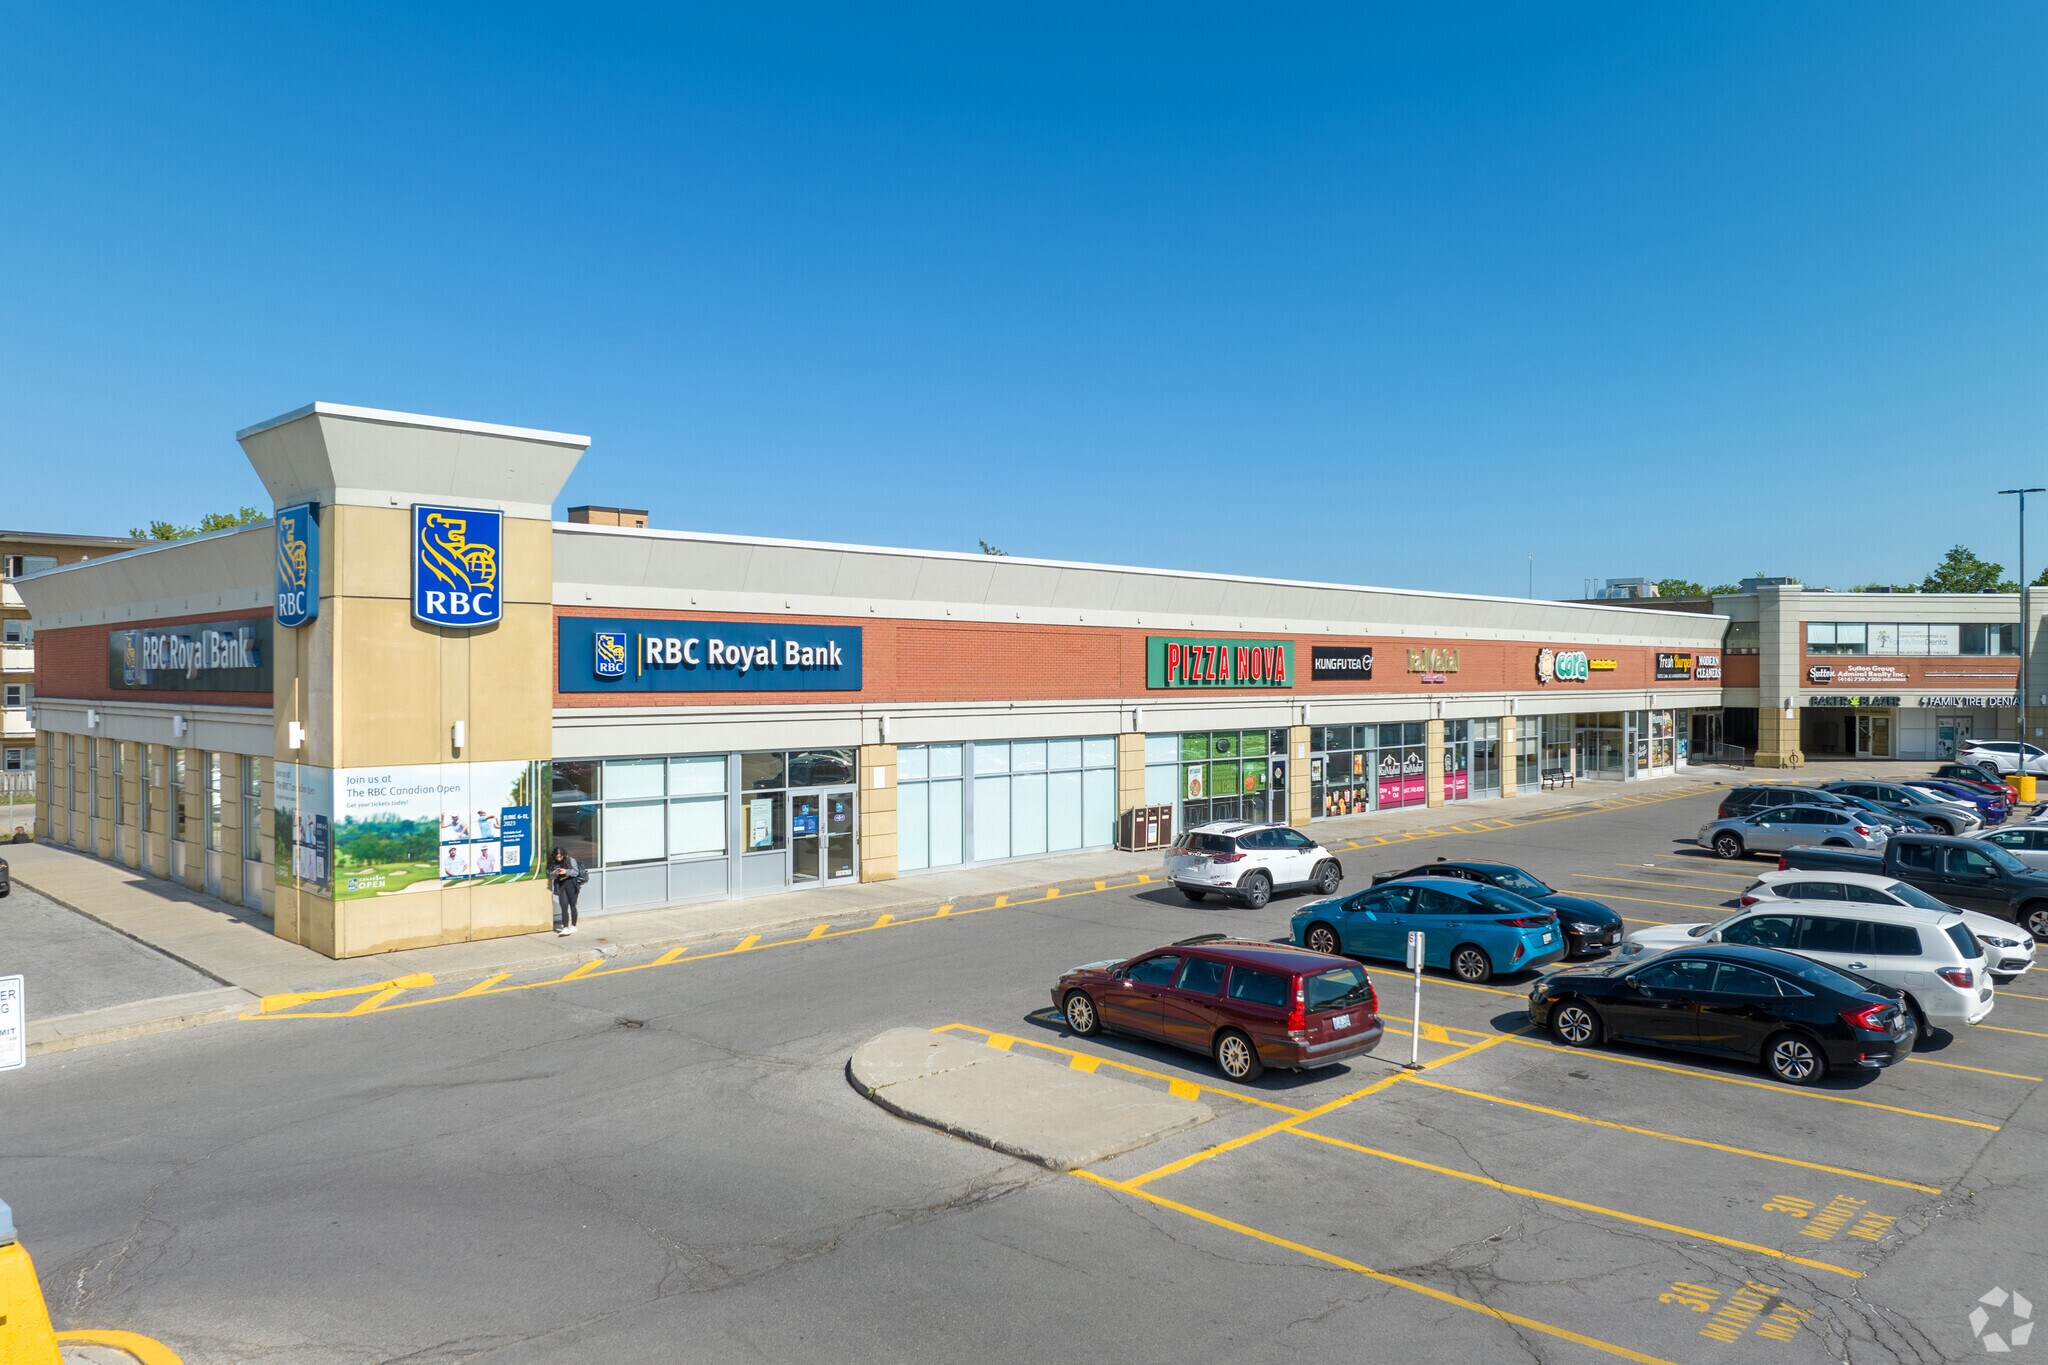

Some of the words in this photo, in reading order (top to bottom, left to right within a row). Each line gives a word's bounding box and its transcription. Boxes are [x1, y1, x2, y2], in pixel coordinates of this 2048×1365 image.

[278, 590, 305, 616] RBC
[425, 590, 493, 616] RBC
[143, 634, 167, 670] RBC
[170, 629, 208, 680] Royal
[210, 626, 256, 669] Bank
[646, 637, 700, 665] RBC
[707, 638, 778, 673] Royal
[783, 640, 843, 667] Bank
[1699, 655, 1720, 665] MODERN
[599, 663, 623, 672] RBC
[1167, 643, 1230, 682] PIZZA
[1237, 645, 1287, 682] NOVA
[1556, 651, 1588, 681] cora
[1659, 654, 1674, 668] Fresh
[1674, 654, 1692, 672] Burger
[1872, 665, 1896, 673] Group
[1696, 668, 1722, 679] CLEANERS
[1809, 667, 1836, 678] Sutton
[1868, 671, 1891, 679] Realty
[1811, 696, 1849, 707] BAKER
[1860, 696, 1901, 707] BLAZER
[1928, 696, 1963, 706] FAMILY
[1964, 696, 1985, 706] TREE
[1989, 696, 2020, 706] DENTA
[346, 775, 365, 786] Join
[367, 776, 379, 784] us
[381, 774, 392, 783] at
[346, 788, 365, 798] The
[367, 787, 387, 797] RBC
[389, 784, 435, 796] Canadian
[436, 784, 461, 794] Open
[359, 880, 386, 889] OPEN
[0, 989, 16, 1001] ER
[0, 1003, 9, 1014] G
[0, 1027, 16, 1036] MIT
[1762, 1194, 1817, 1219] 30
[1798, 1193, 1868, 1241] MINUTE
[1846, 1211, 1898, 1241] MAX
[1658, 1281, 1721, 1313] 30
[1698, 1279, 1781, 1344] MINUTE
[1755, 1302, 1815, 1343] MAX
